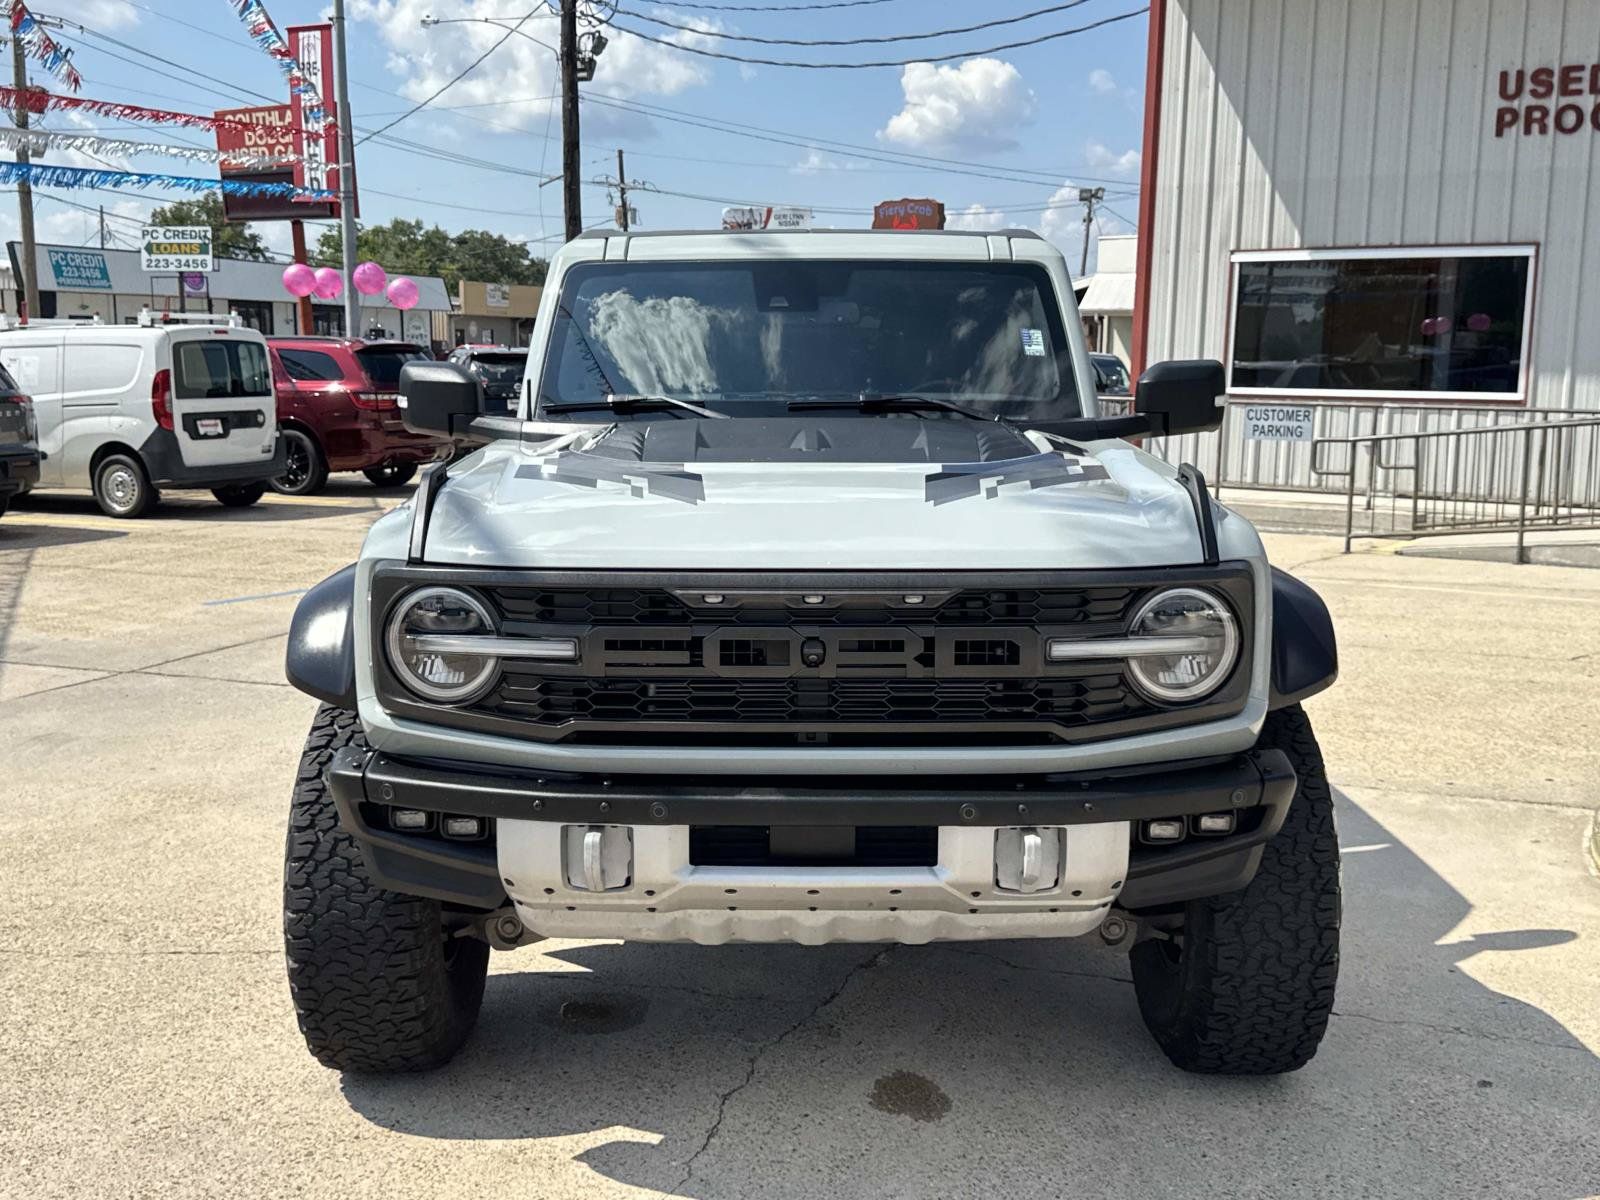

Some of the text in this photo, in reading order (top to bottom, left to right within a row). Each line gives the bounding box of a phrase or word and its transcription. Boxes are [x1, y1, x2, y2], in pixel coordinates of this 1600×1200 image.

[907, 203, 933, 216] Crab
[142, 229, 209, 240] PC CREDIT
[152, 243, 200, 254] LOANS
[50, 252, 104, 268] PC CREDIT
[146, 258, 208, 268] 223-3456
[1247, 408, 1311, 422] CUSTOMER
[1252, 424, 1303, 438] PARKING
[585, 625, 1043, 679] FORD
